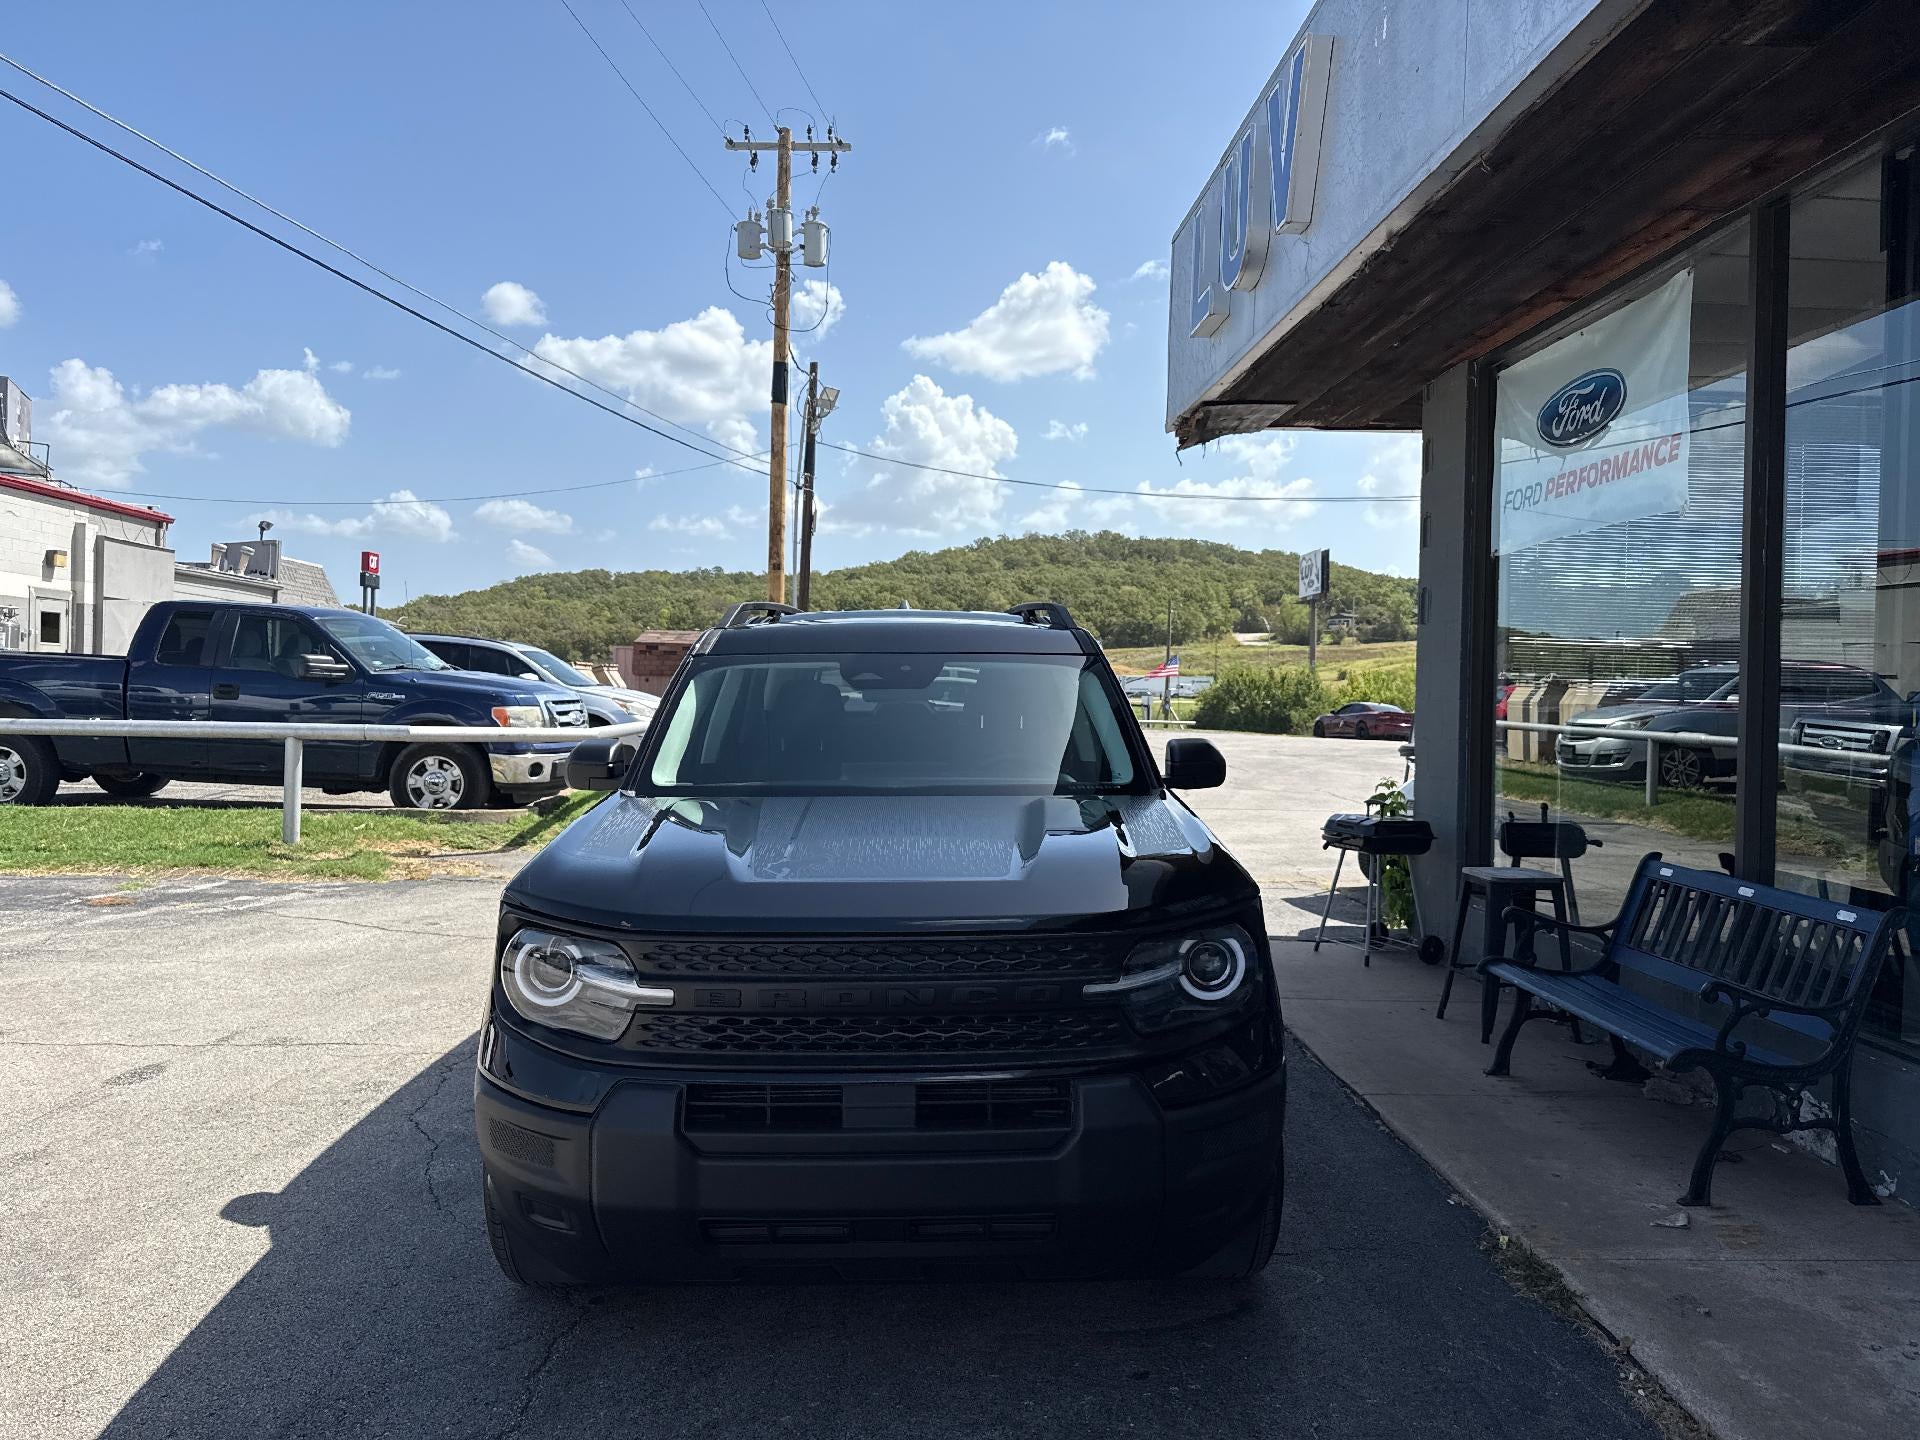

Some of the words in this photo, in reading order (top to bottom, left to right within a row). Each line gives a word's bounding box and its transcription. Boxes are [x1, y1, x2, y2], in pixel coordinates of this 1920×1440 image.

[1190, 33, 1322, 337] LUV
[1552, 382, 1608, 437] Ford
[1503, 482, 1543, 514] FORD
[1544, 432, 1682, 501] PERFORMANCE
[694, 985, 1061, 1008] BRONCO
